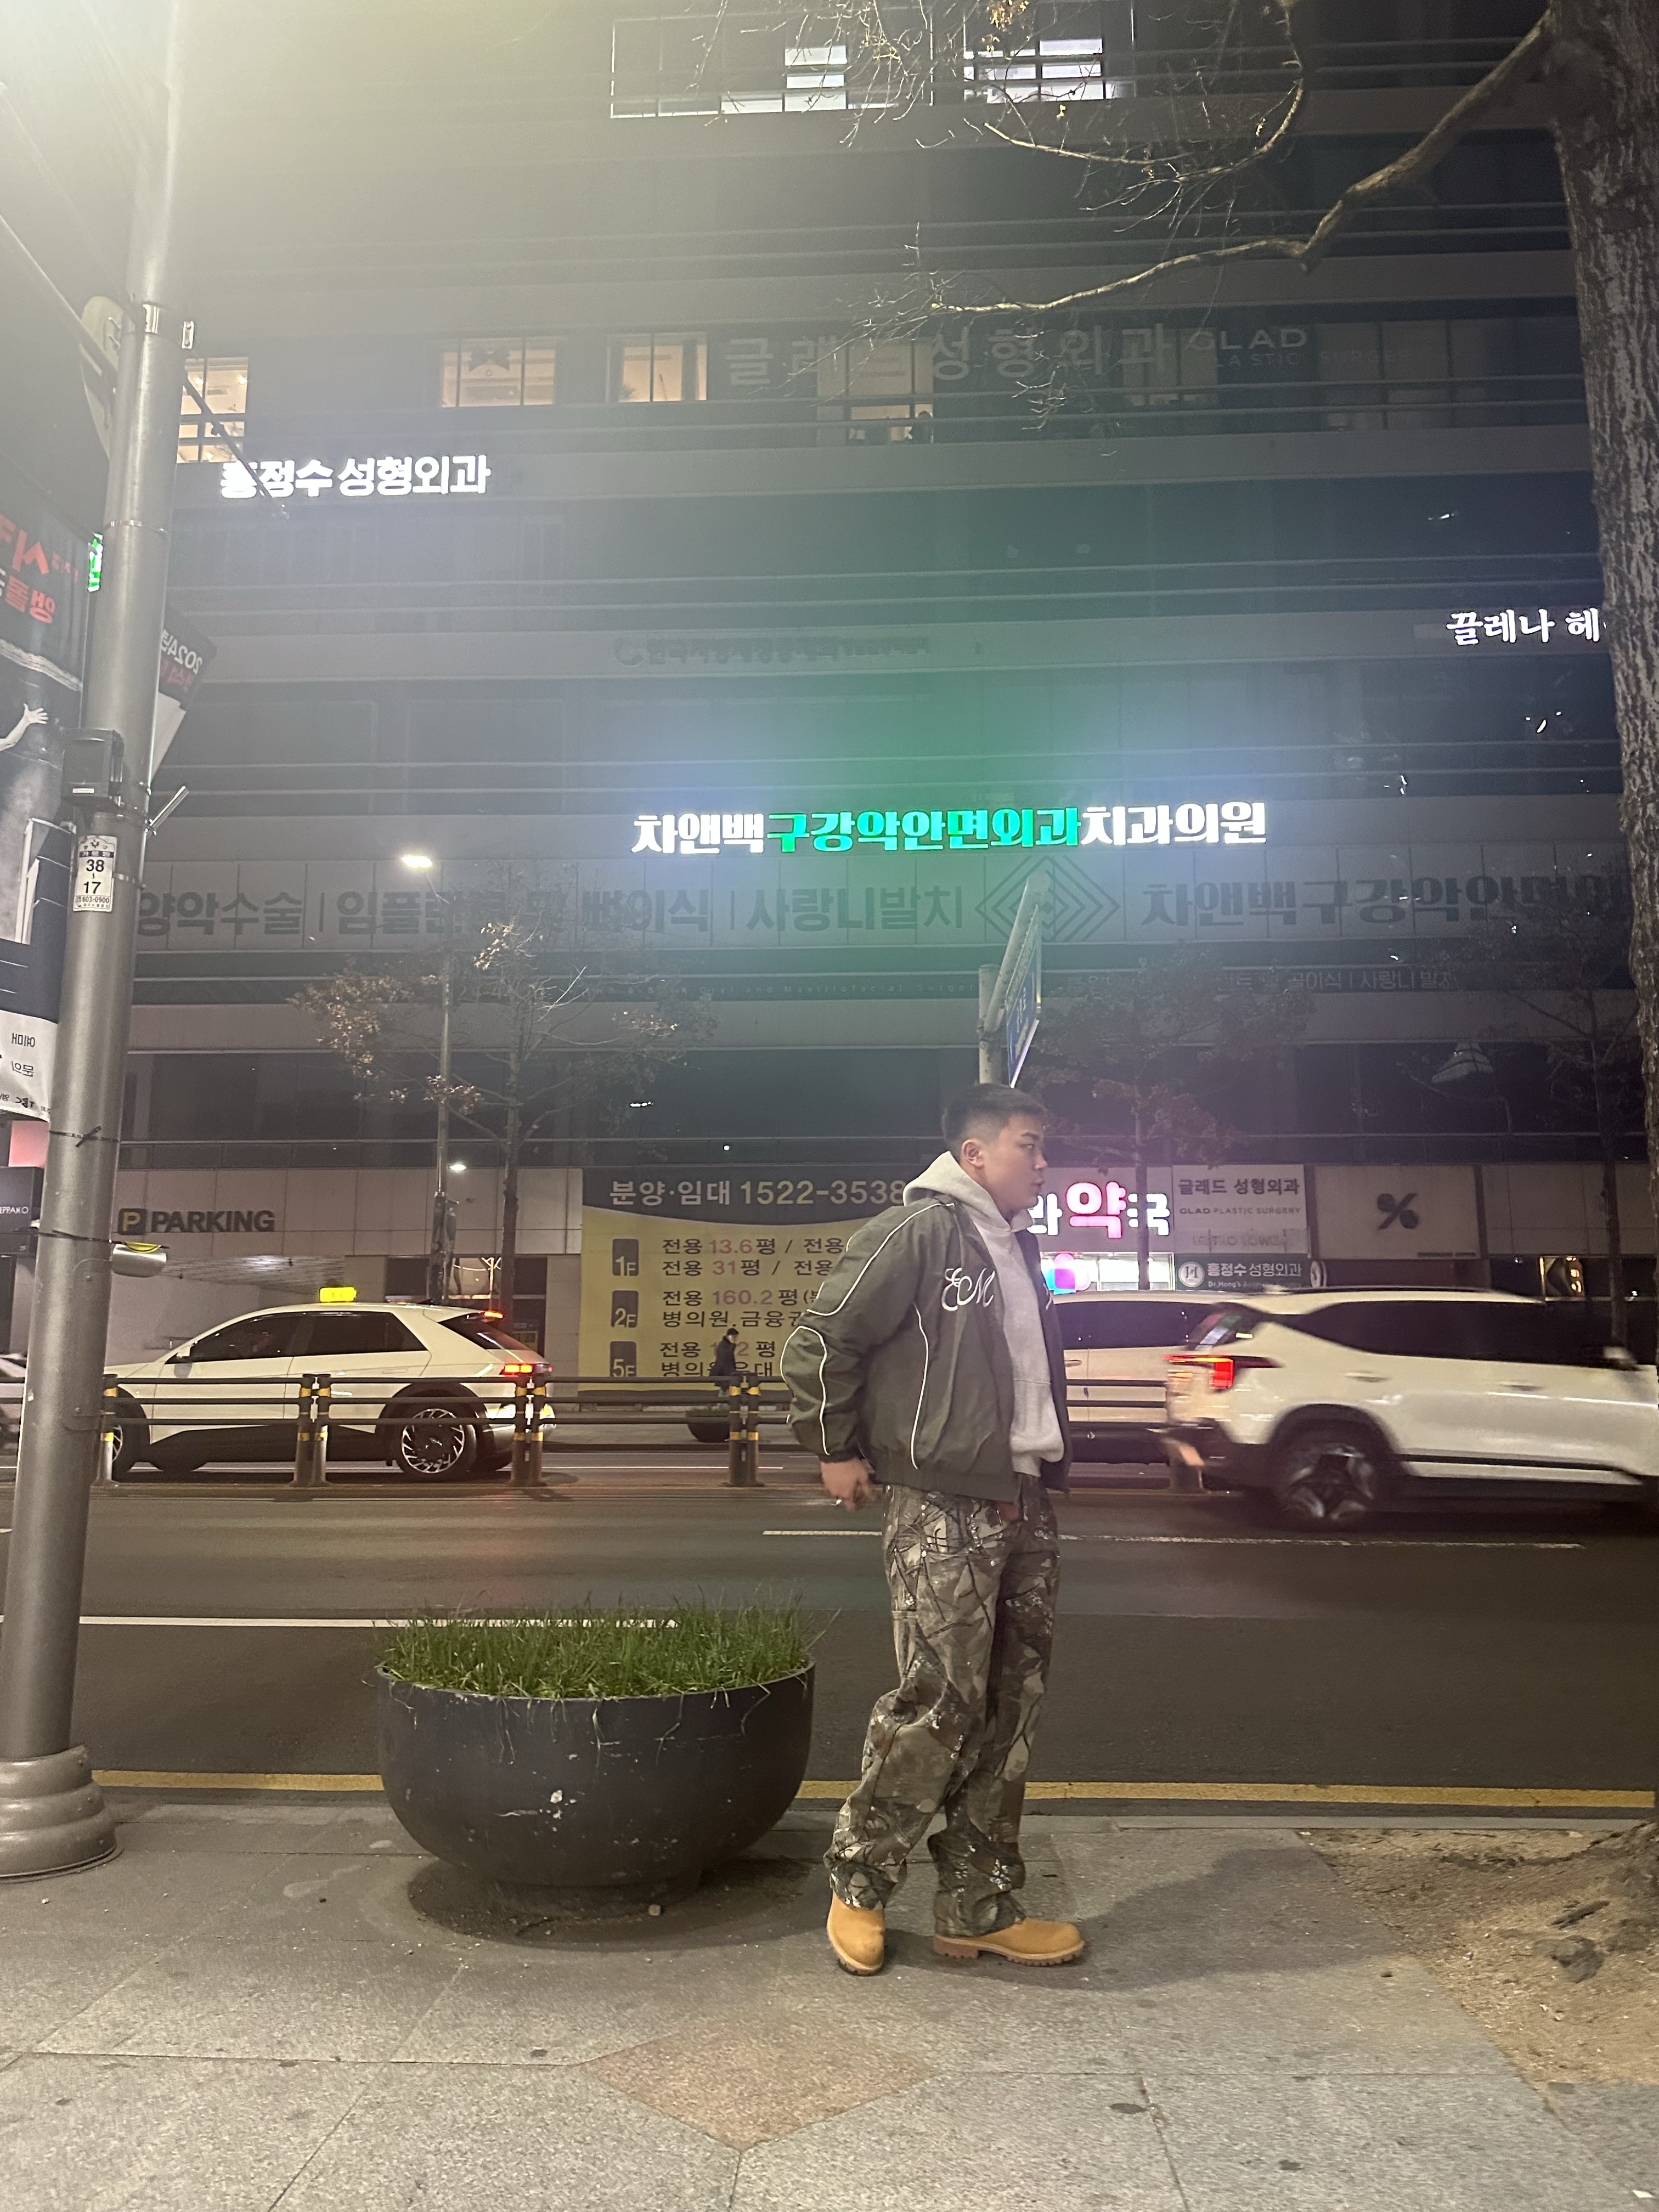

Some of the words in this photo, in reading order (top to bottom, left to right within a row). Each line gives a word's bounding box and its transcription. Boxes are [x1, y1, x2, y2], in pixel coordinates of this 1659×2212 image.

[338, 454, 492, 496] 성형외과
[1446, 607, 1555, 646] 끌레나
[1565, 607, 1606, 643] 헤
[86, 859, 105, 872] 38
[83, 881, 101, 894] 17
[747, 885, 963, 932] 사랑니발치
[1358, 969, 1415, 990] 사랑니
[917, 983, 975, 994] Surger
[610, 1180, 730, 1206] 분양·임대
[740, 1180, 906, 1205] 1522-3538
[1178, 1179, 1227, 1195] 글래드
[1234, 1178, 1300, 1195] 성형외과
[150, 1210, 275, 1233] PARKING
[662, 1238, 703, 1255] 전용
[803, 1238, 844, 1254] 전용
[615, 1256, 637, 1277] 1F
[662, 1260, 703, 1276] 전용
[794, 1260, 833, 1276] 전용
[1207, 1262, 1248, 1277] 홍정수
[1248, 1263, 1302, 1277] 성형외과
[663, 1290, 703, 1306] 전용
[613, 1307, 637, 1328] 2F
[660, 1341, 701, 1358] 전용
